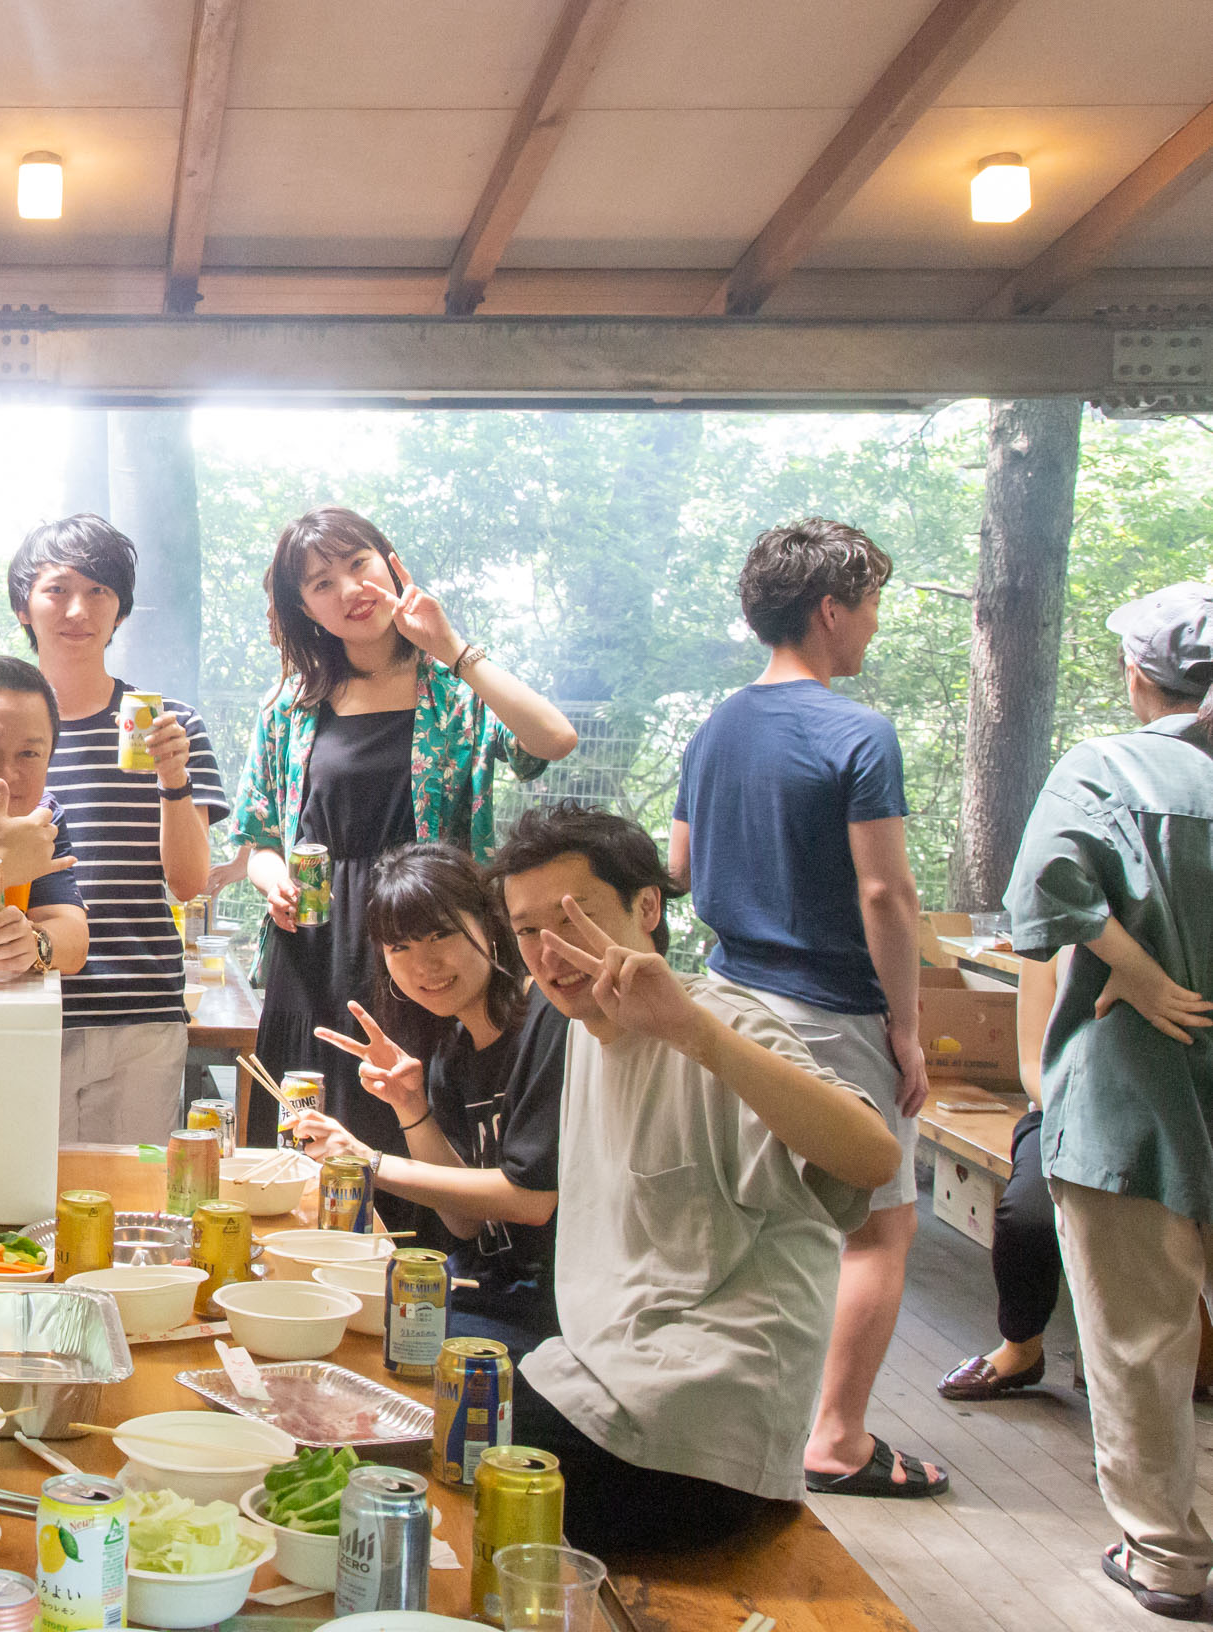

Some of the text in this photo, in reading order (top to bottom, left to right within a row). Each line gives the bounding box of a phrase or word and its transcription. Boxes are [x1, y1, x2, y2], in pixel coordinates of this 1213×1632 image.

[282, 1096, 316, 1112] SRONG
[399, 1280, 440, 1293] PREMIUM
[340, 1552, 370, 1573] ZERO
